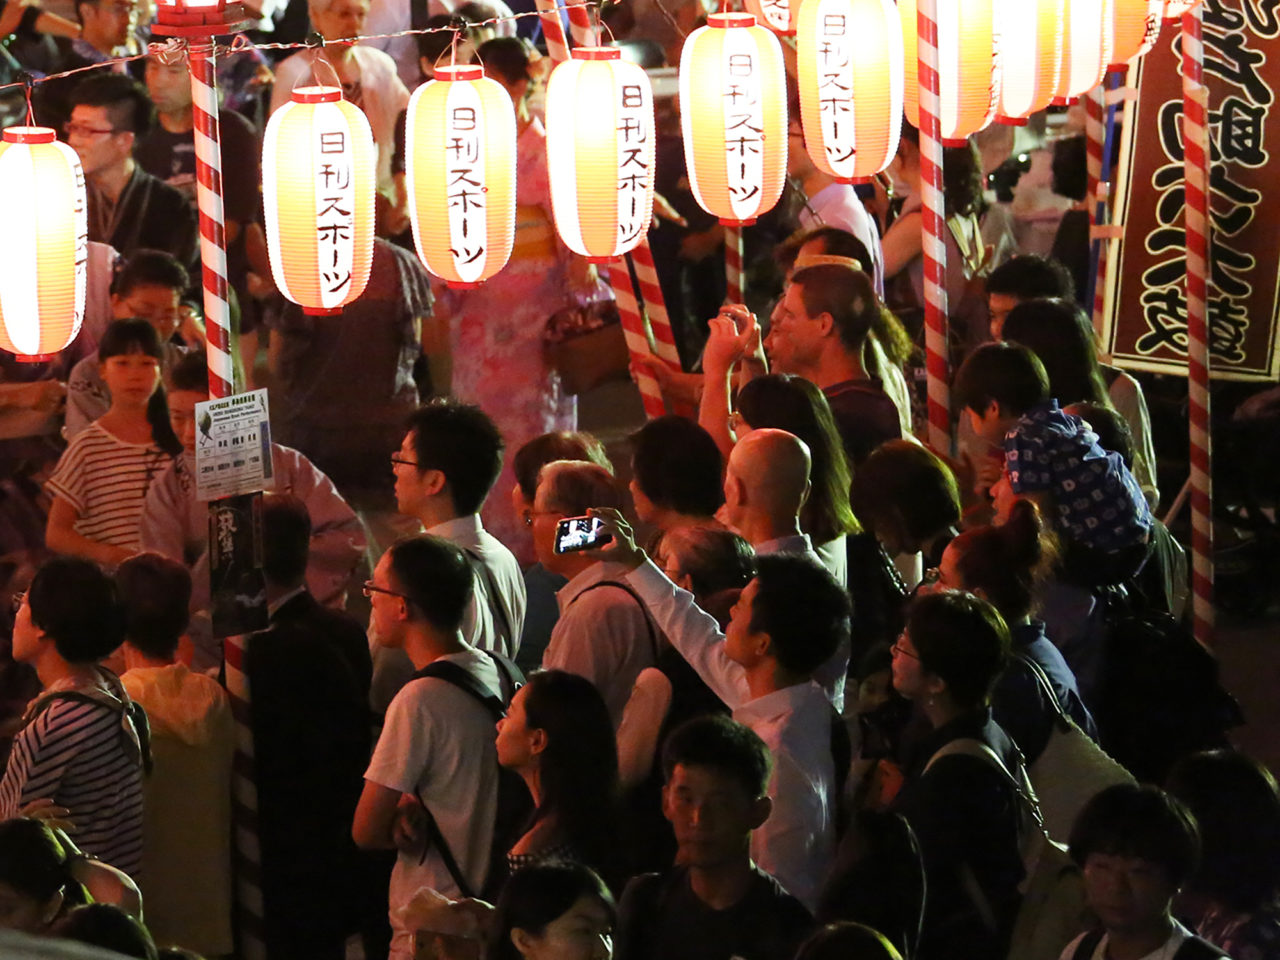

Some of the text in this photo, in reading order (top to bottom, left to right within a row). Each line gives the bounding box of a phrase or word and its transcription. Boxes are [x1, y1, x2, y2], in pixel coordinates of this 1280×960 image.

[616, 85, 651, 244] 日刊スポーツ
[723, 53, 767, 202] 日刊スポーツ
[819, 13, 856, 162] 日刊スポーツ
[317, 131, 354, 293] 日刊スポーツ
[446, 106, 489, 265] 日刊スポーツ
